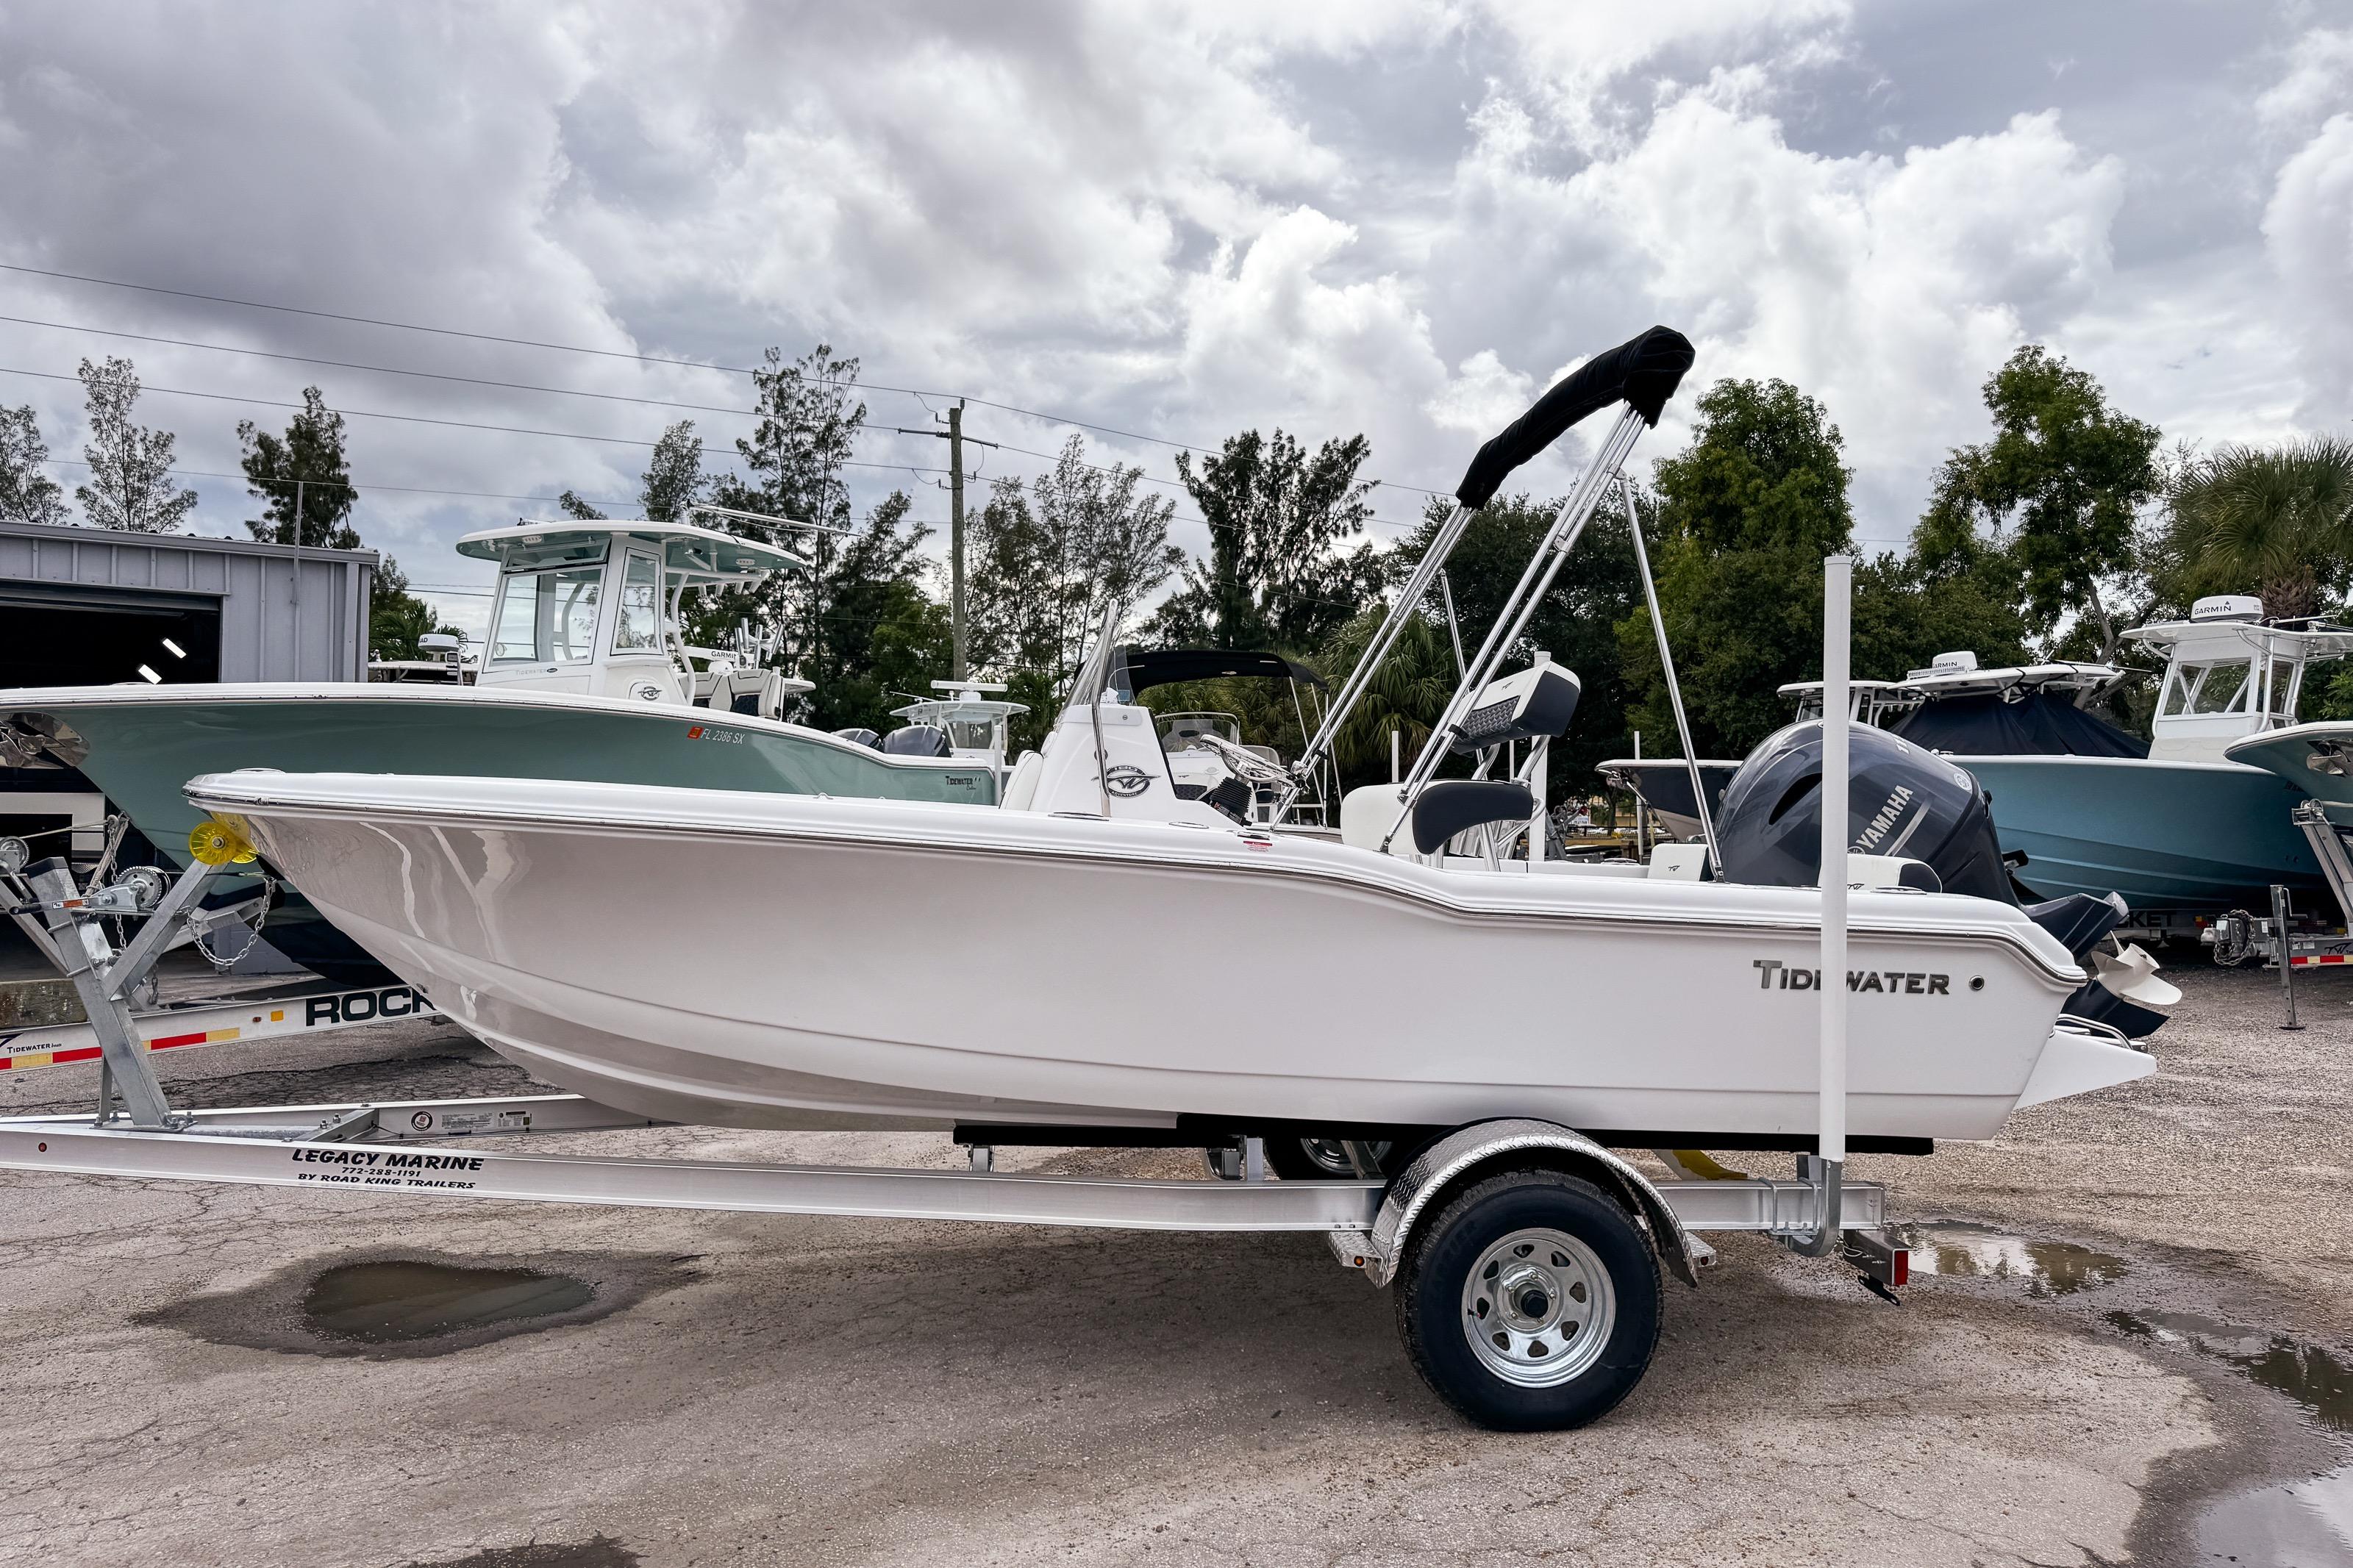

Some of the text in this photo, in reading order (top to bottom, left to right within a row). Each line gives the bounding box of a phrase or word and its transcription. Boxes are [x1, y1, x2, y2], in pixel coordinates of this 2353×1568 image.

[2194, 606, 2232, 615] GARMIN
[701, 728, 711, 740] FL
[713, 730, 733, 742] 2386
[733, 733, 746, 744] SX
[1855, 784, 1914, 850] YAMAHA
[1753, 959, 1950, 995] TIDWATER
[7, 1043, 50, 1053] TIDEWATER
[292, 1148, 484, 1171] LEGACY MARINE
[341, 1167, 421, 1177] 772-288-1191
[321, 1174, 360, 1184] ROAD
[365, 1177, 401, 1186] KING
[407, 1179, 476, 1189] TRAILERS
